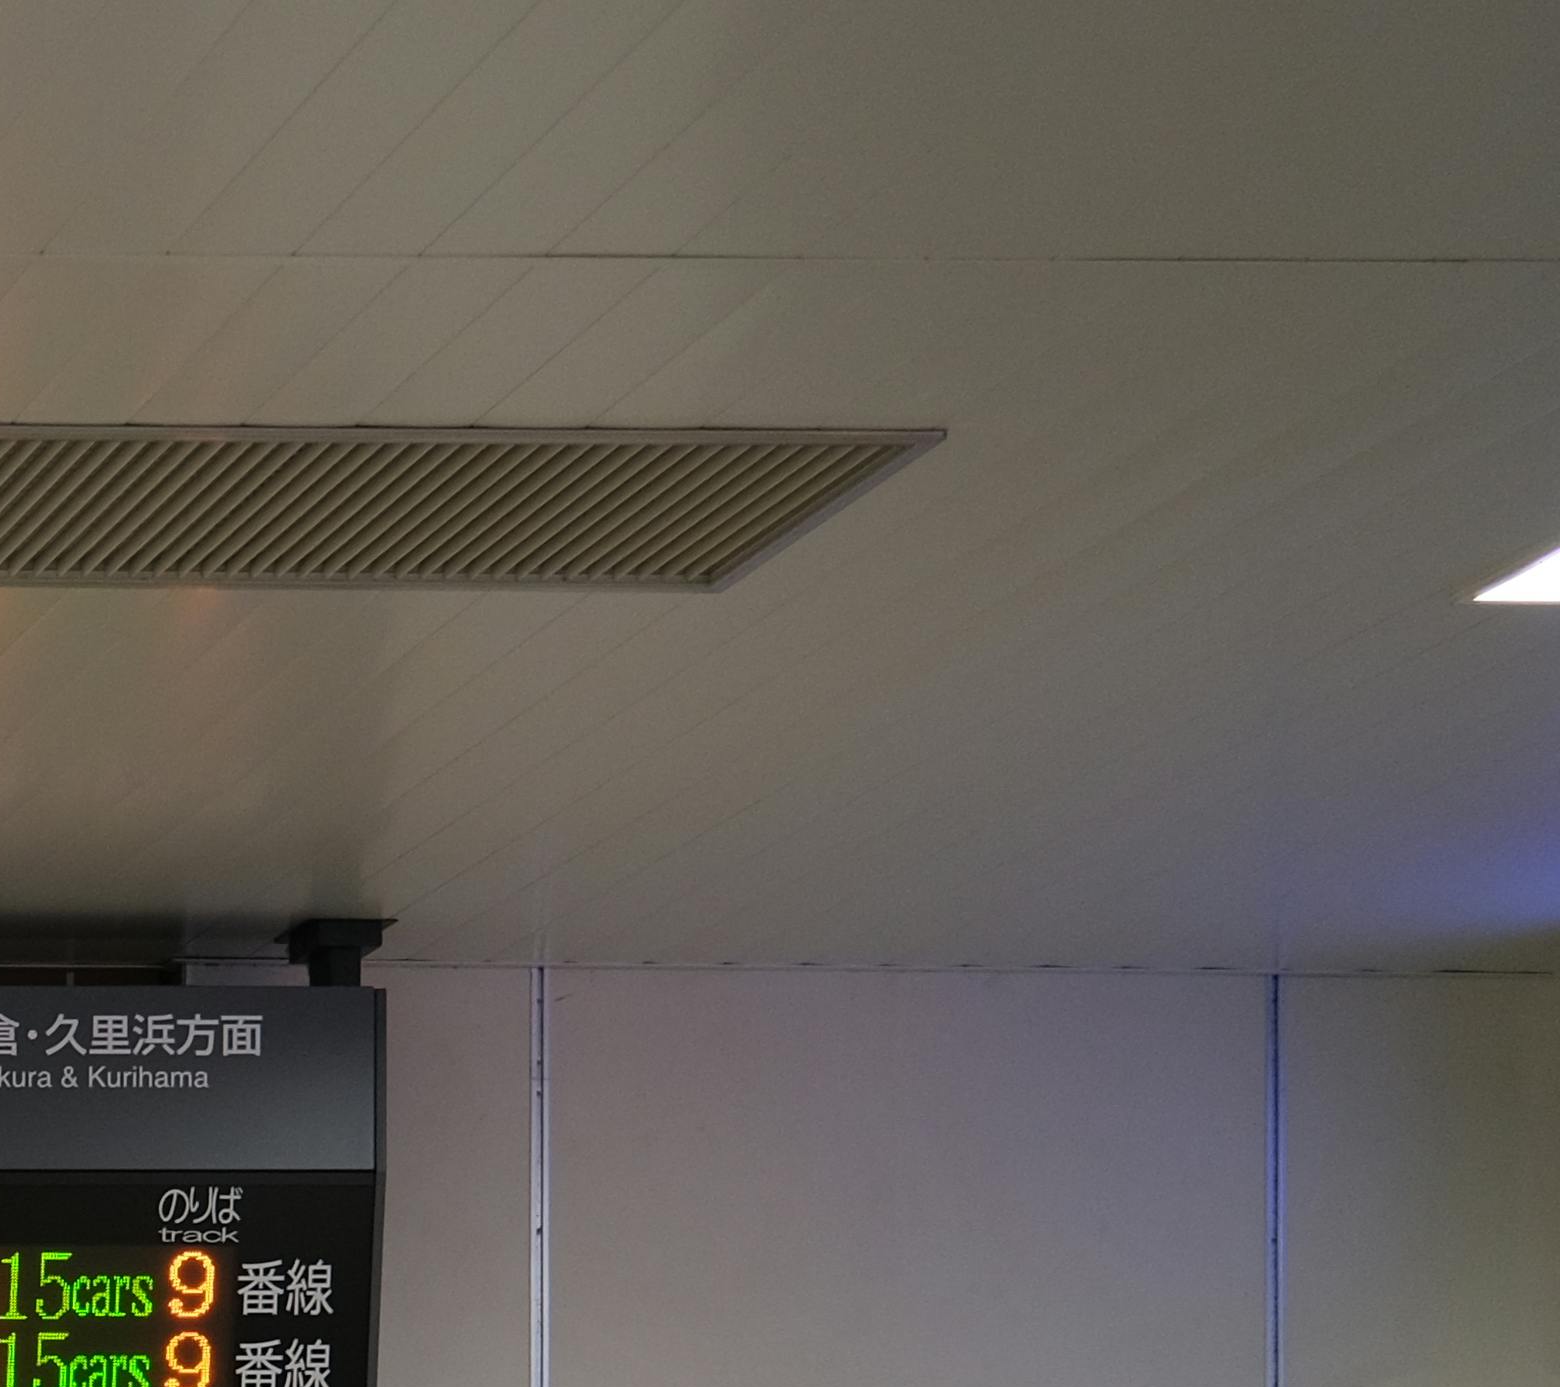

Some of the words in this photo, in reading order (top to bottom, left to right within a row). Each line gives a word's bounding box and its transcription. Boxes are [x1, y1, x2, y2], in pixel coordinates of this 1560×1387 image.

[62, 1066, 79, 1088] &
[89, 1066, 209, 1089] Kurihama
[159, 1186, 242, 1225] のりば
[160, 1227, 239, 1244] track
[167, 1251, 215, 1319] 9
[236, 1260, 334, 1316] 番線
